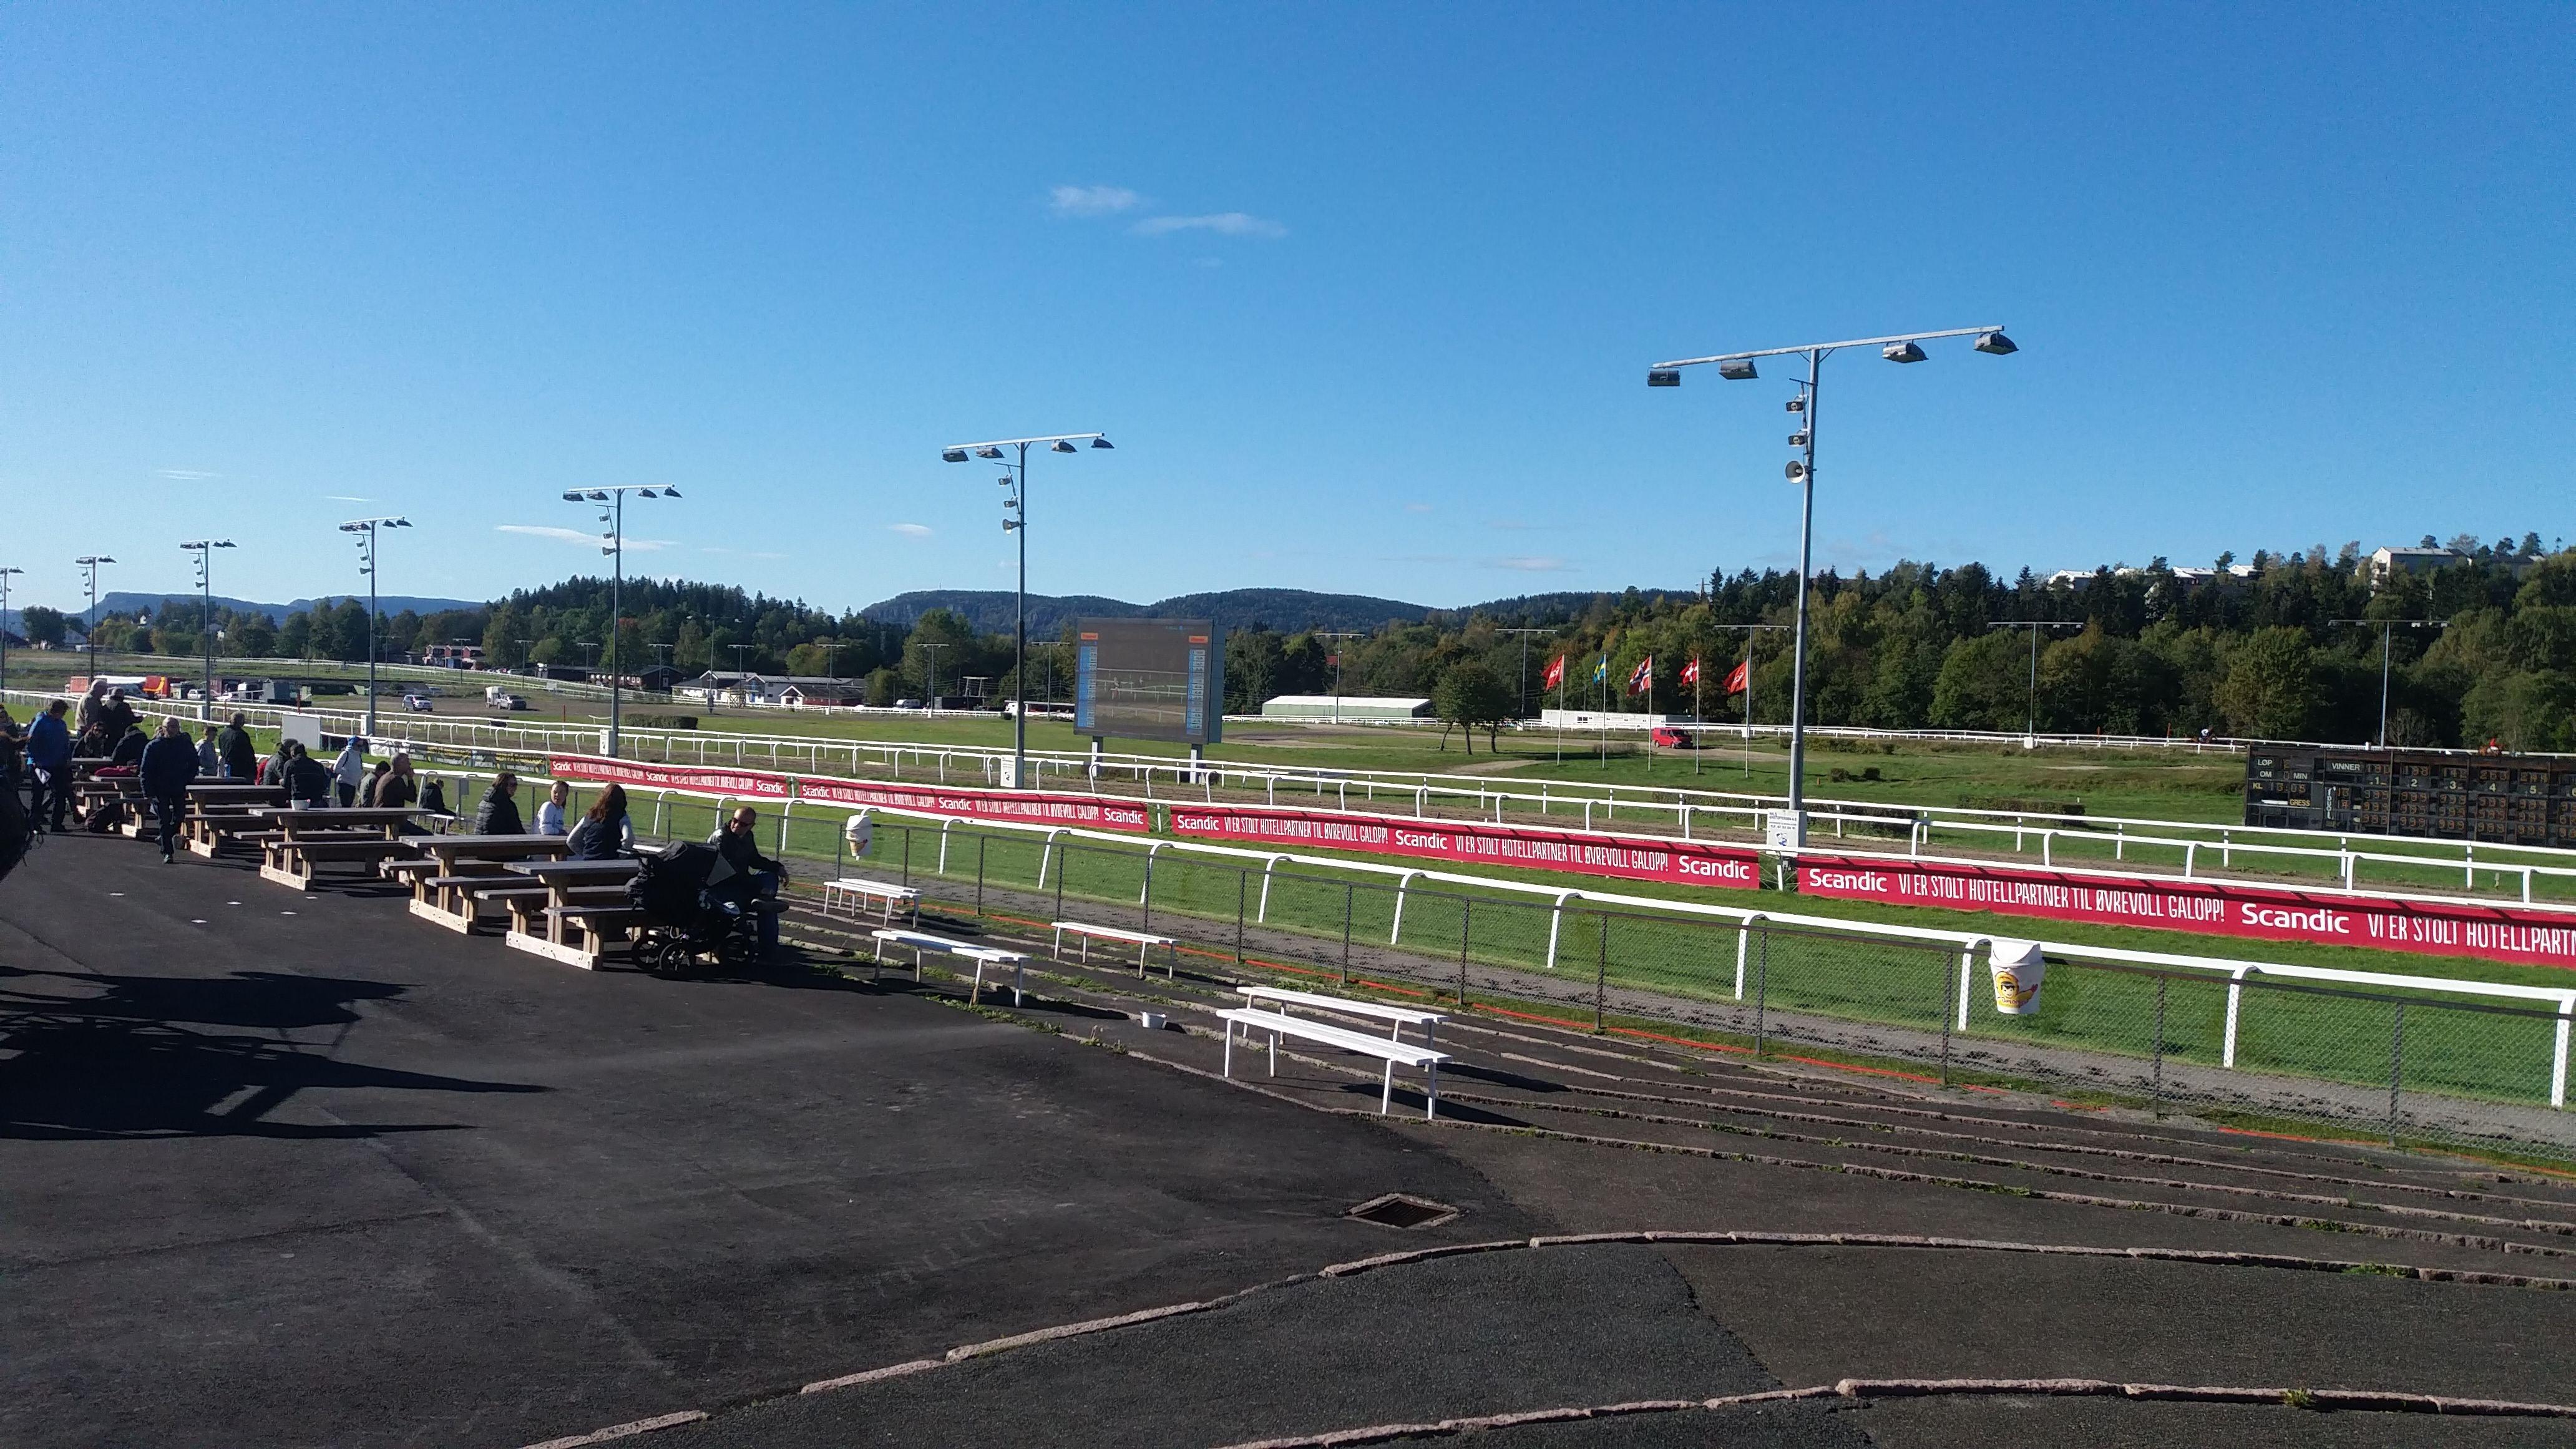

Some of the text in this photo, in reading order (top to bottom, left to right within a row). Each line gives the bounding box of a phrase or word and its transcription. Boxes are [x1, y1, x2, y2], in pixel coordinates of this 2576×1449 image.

[2331, 763, 2360, 771] VINNER
[756, 779, 784, 794] Scandic
[2375, 776, 2379, 784] 1
[2411, 779, 2417, 787] 2
[2449, 781, 2456, 789] 3
[2489, 783, 2496, 792] 4
[2530, 786, 2537, 794] 5
[802, 785, 830, 798] Scandic
[938, 797, 972, 811] Scandic
[1104, 808, 1143, 824] Scandic
[1178, 815, 1750, 880] Scandic VI ER STOLT HOTELLPARTNER TIL ØVREVOLL GALOPP! Scandic VI ER STOLT HOTELLPARTNER TIL ØVREVOLL GALOPP! Scandic
[1809, 868, 1888, 893] Scandic
[1898, 874, 1910, 895] VI
[1914, 875, 1928, 897] ER
[1931, 876, 1963, 900] STOLT
[1969, 879, 2069, 909] HOTELLPARTNER
[2071, 887, 2092, 910] TIL
[2095, 887, 2164, 917] ØVREVOLL
[2168, 895, 2225, 922] GALOPP!
[2242, 902, 2350, 934] Scandic
[2367, 912, 2384, 938] VI
[2389, 915, 2408, 940] ER
[2413, 917, 2460, 945] STOLT
